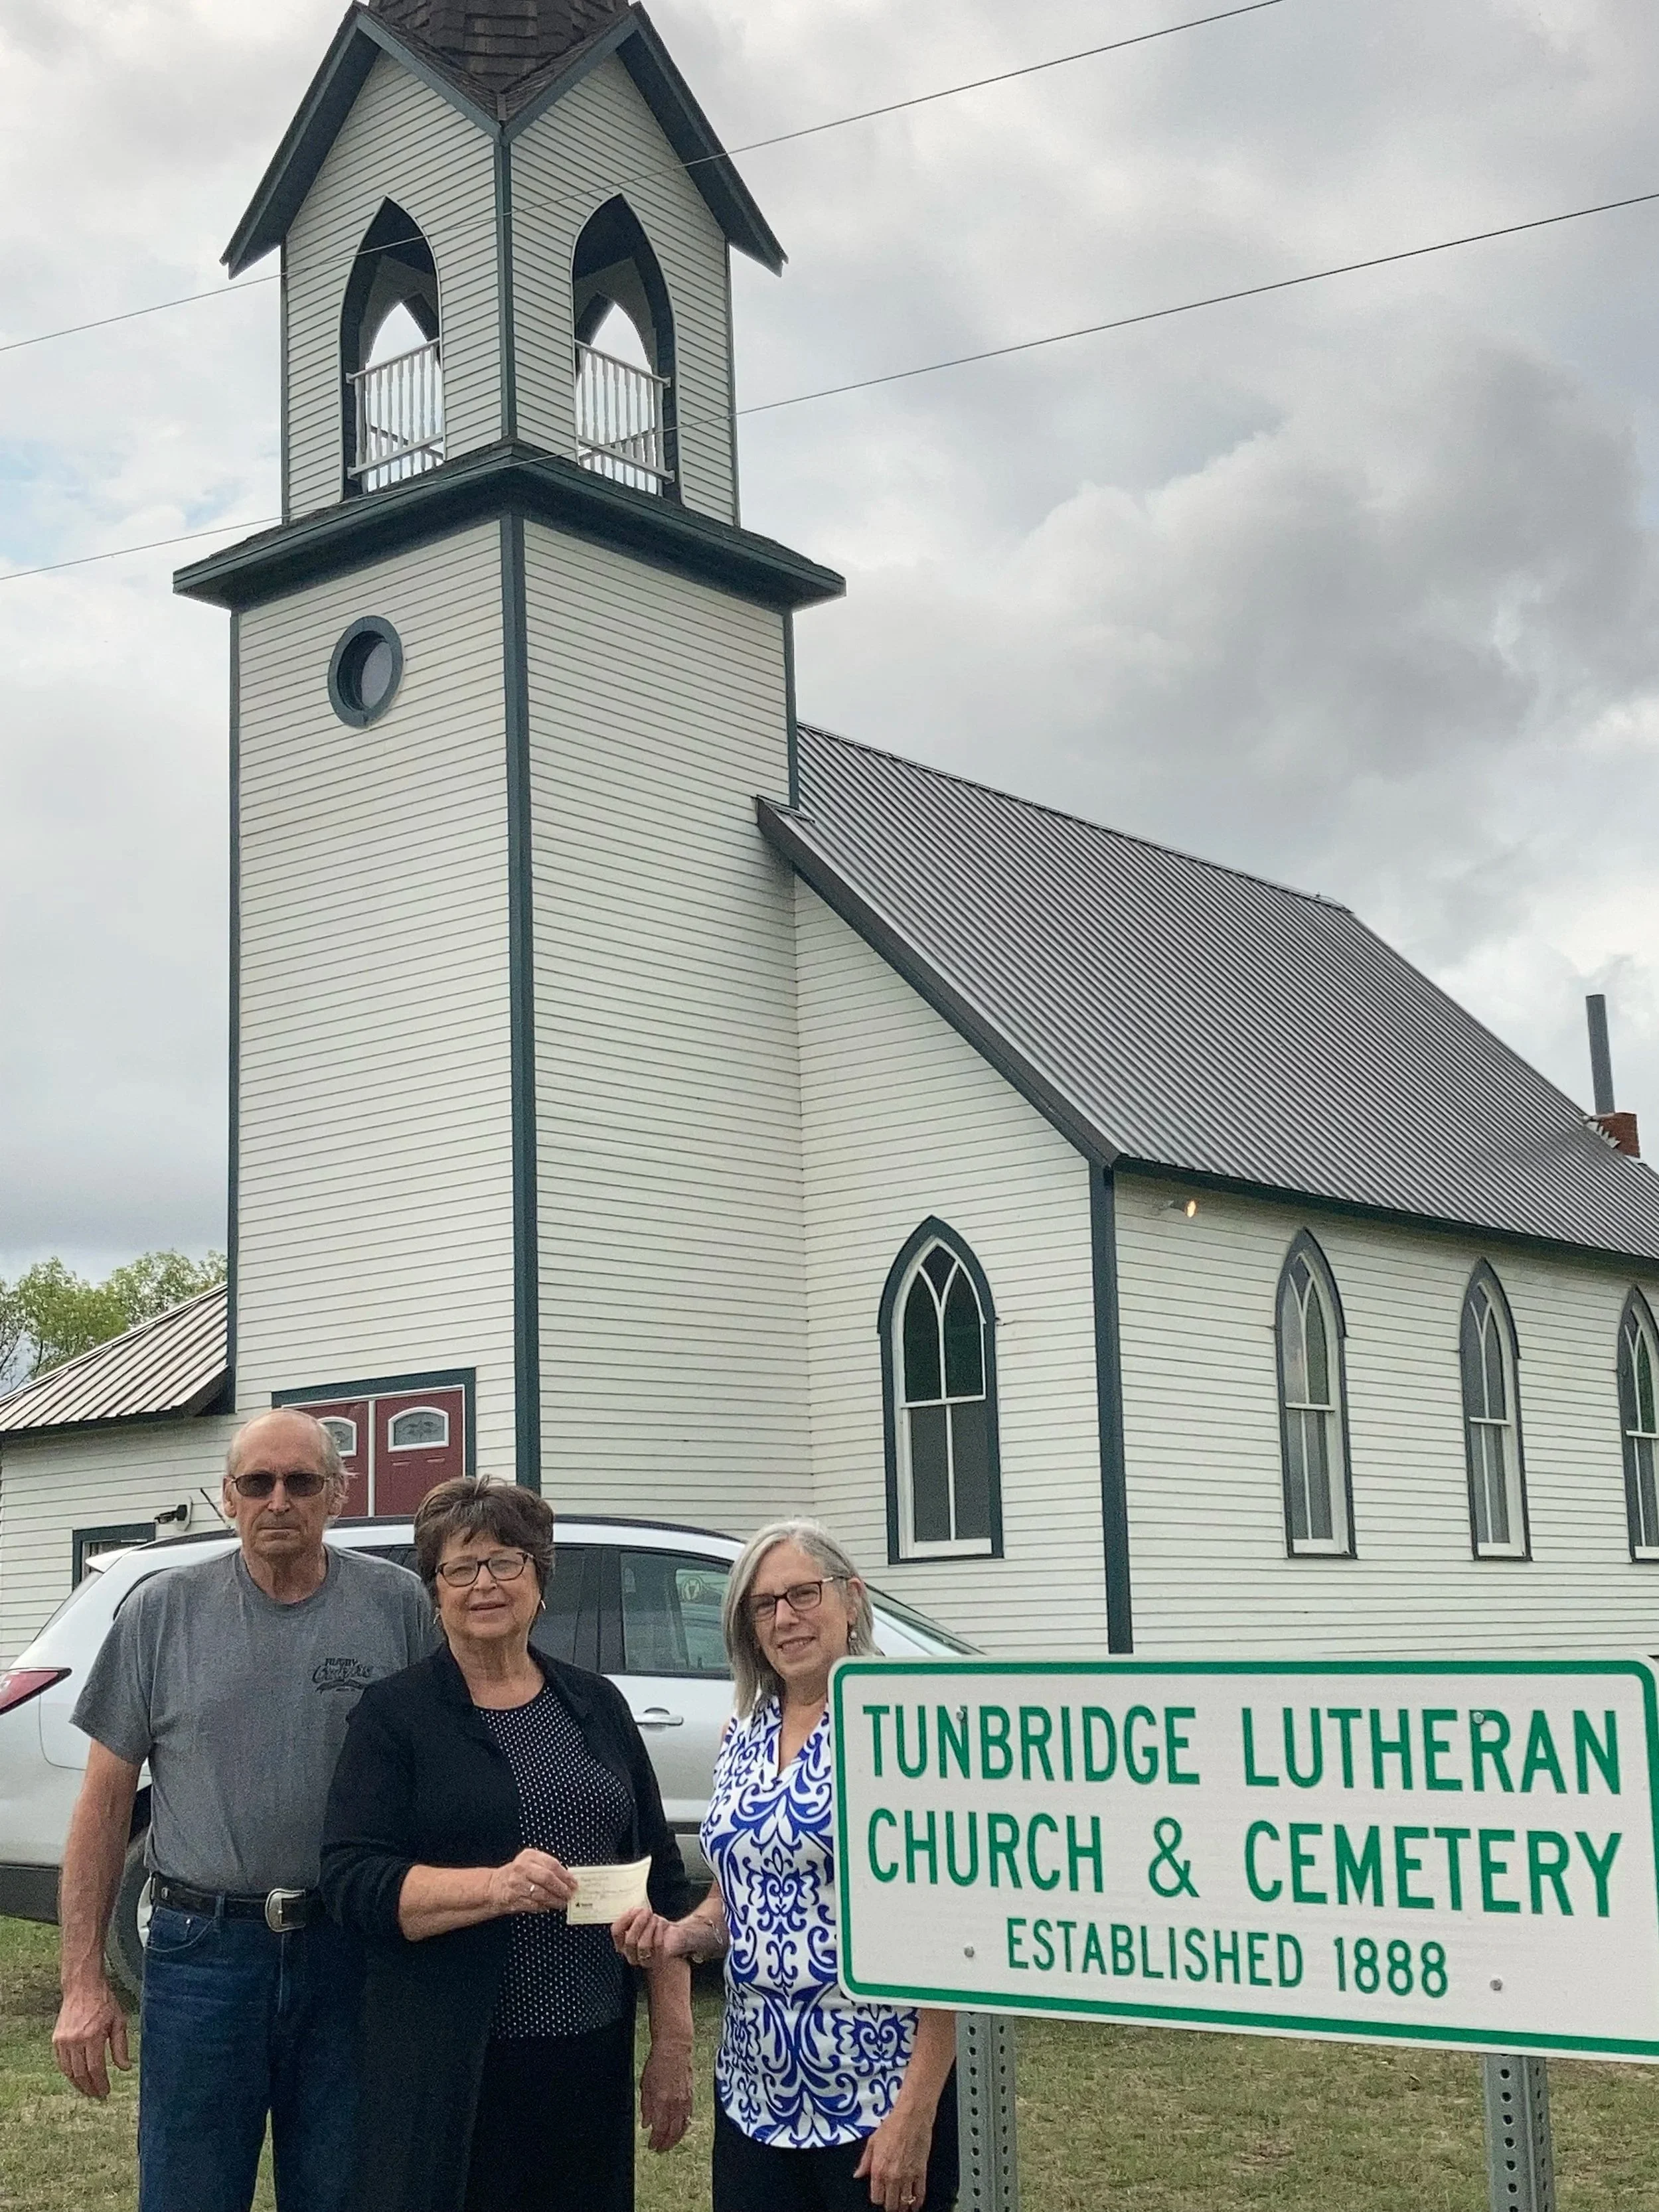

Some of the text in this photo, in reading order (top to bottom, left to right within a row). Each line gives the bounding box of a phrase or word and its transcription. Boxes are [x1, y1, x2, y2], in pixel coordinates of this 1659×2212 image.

[862, 1705, 1621, 1795] TUNBRIDGE LUTHERAN
[868, 1808, 1622, 1917] CHURCH & CEMETERY
[1007, 1917, 1449, 1998] ESTABLISHED 1888
